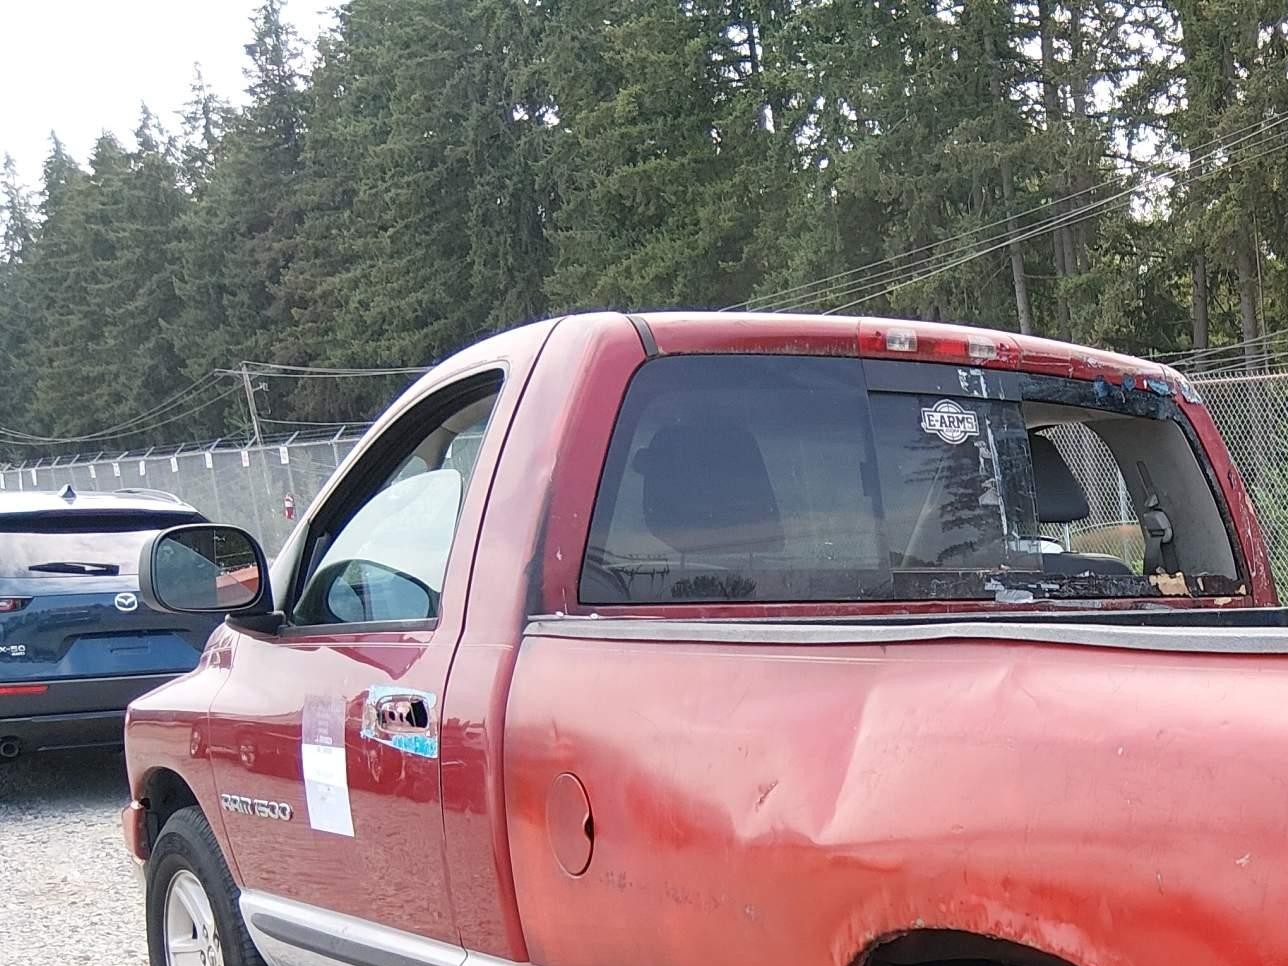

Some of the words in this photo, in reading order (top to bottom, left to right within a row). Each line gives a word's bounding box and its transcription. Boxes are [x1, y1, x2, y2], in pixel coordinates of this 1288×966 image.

[926, 414, 974, 430] E-ARMS
[221, 794, 253, 815] RAM
[254, 799, 291, 821] 1500
